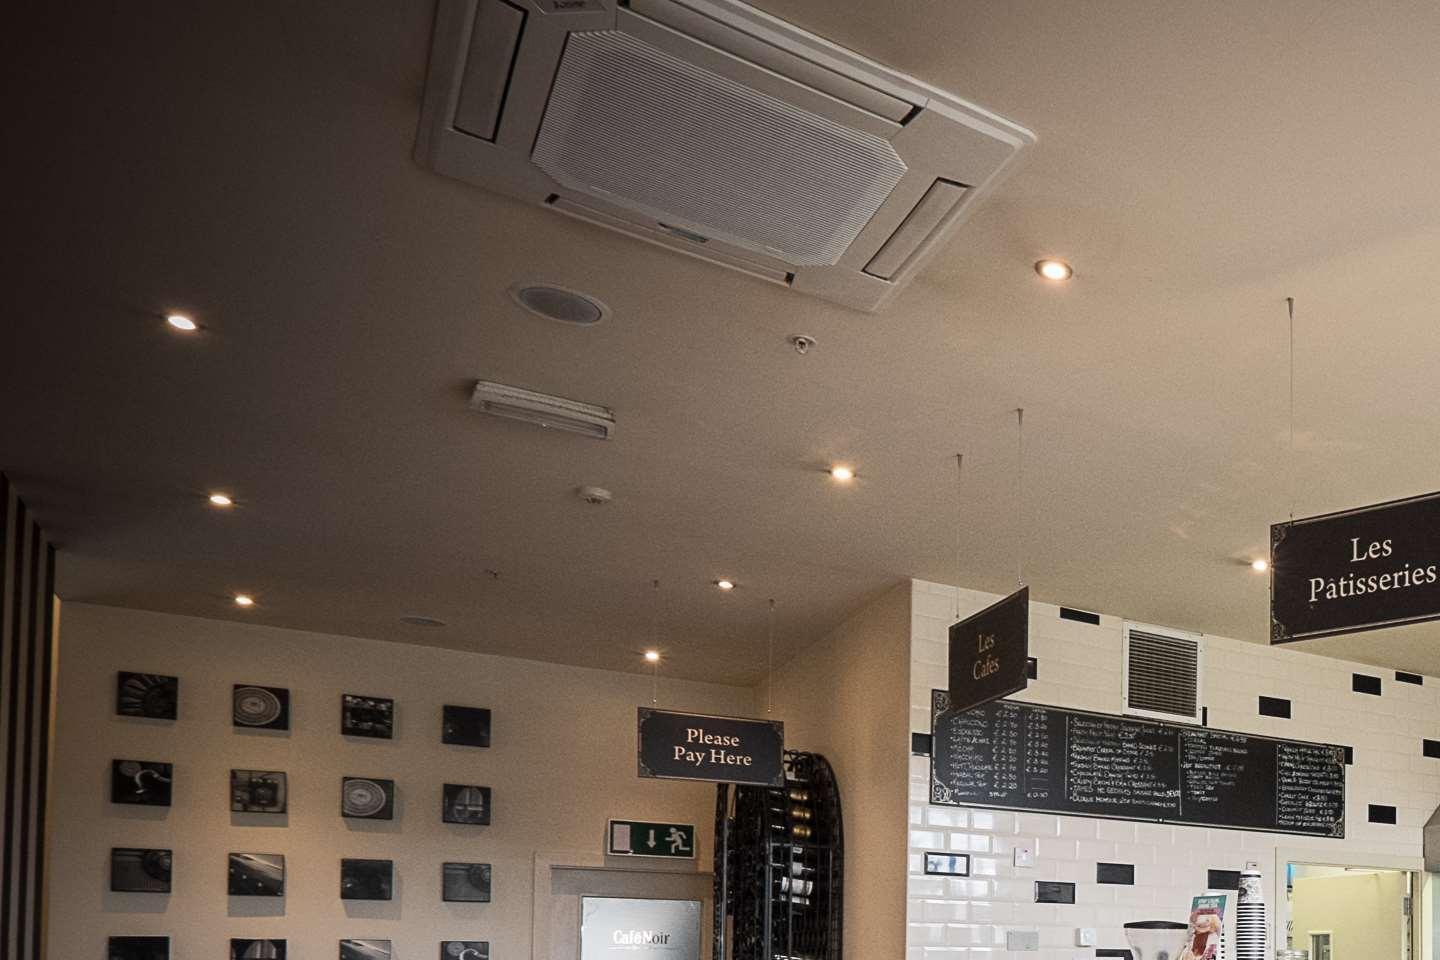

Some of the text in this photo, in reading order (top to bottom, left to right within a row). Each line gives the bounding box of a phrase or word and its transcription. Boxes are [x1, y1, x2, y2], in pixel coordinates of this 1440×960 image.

[1350, 537, 1393, 563] Les
[1308, 563, 1437, 603] Pâtisseries
[978, 634, 995, 653] Les
[973, 654, 1000, 680] Cafés
[687, 728, 740, 747] Please
[673, 745, 753, 766] Pay Here
